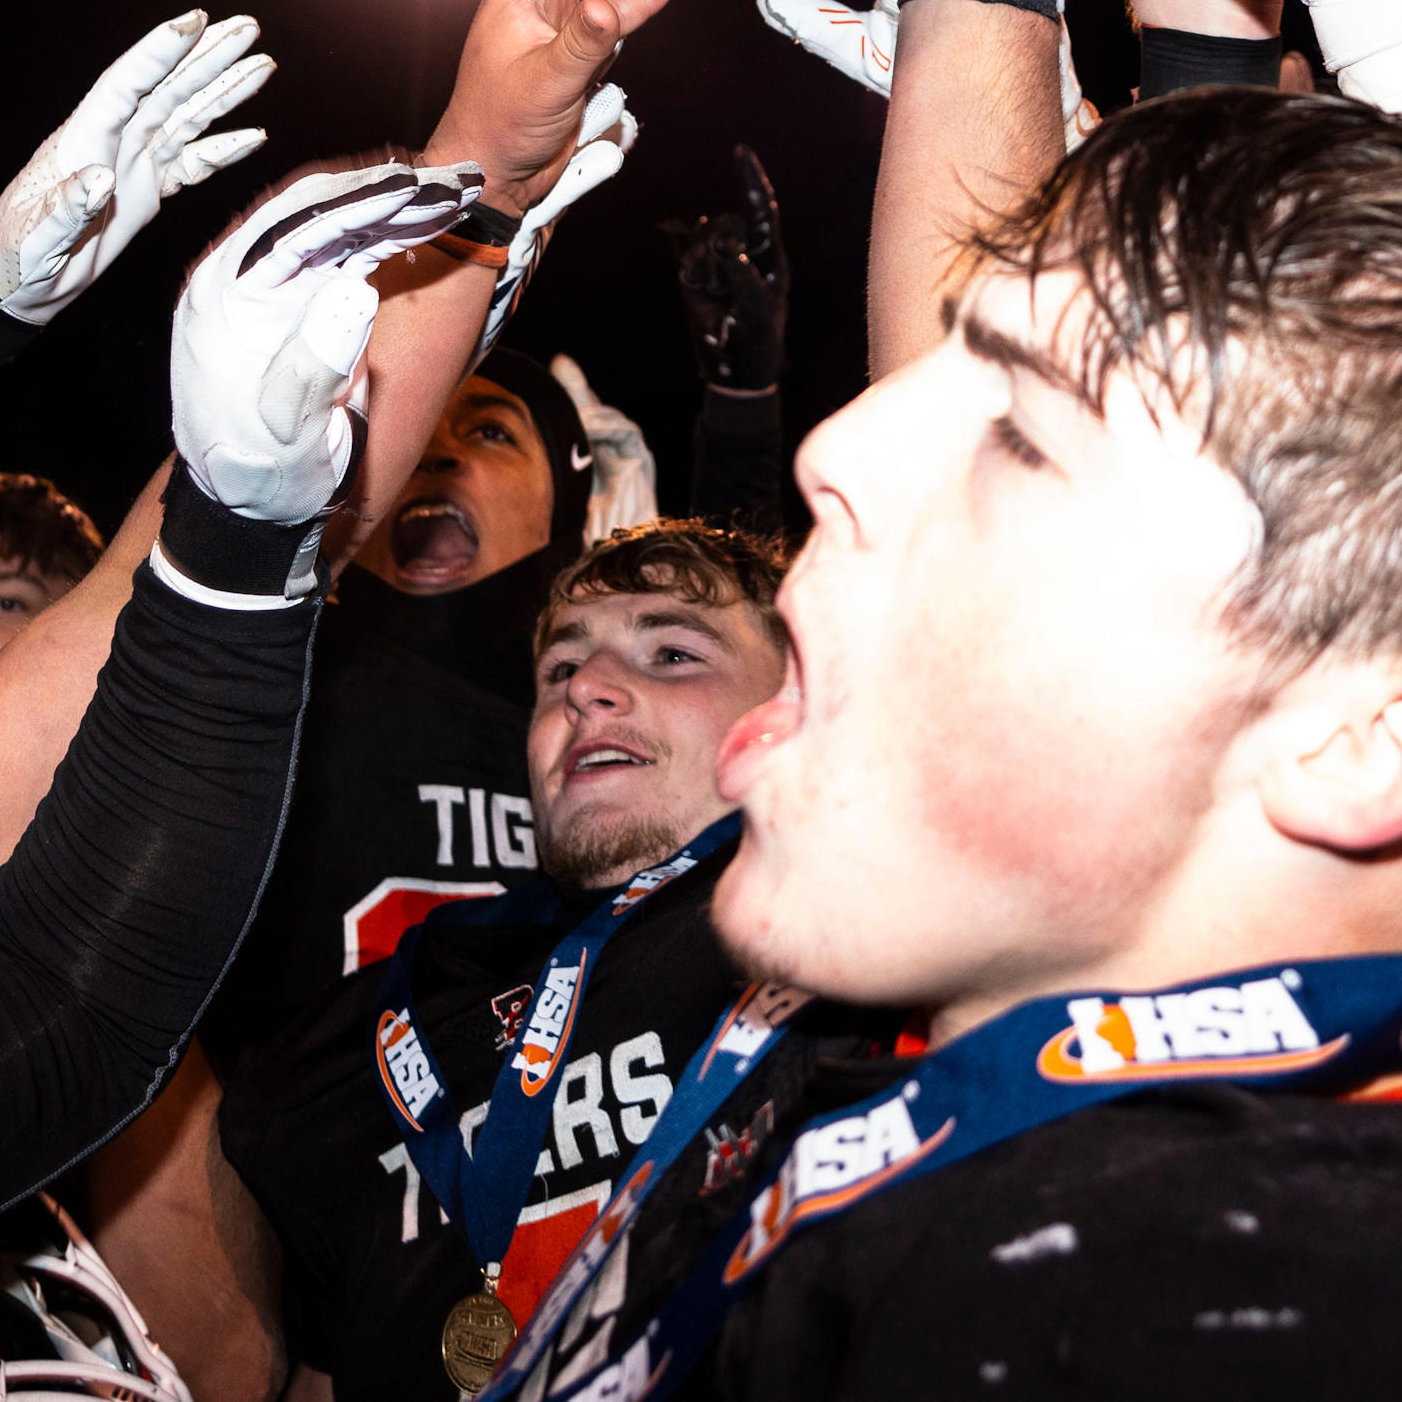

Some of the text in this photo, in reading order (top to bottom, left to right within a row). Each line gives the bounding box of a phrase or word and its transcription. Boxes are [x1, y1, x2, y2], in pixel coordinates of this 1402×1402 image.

[417, 783, 539, 870] TIG
[511, 965, 581, 1080] IHSA
[1067, 977, 1320, 1073] IHSA
